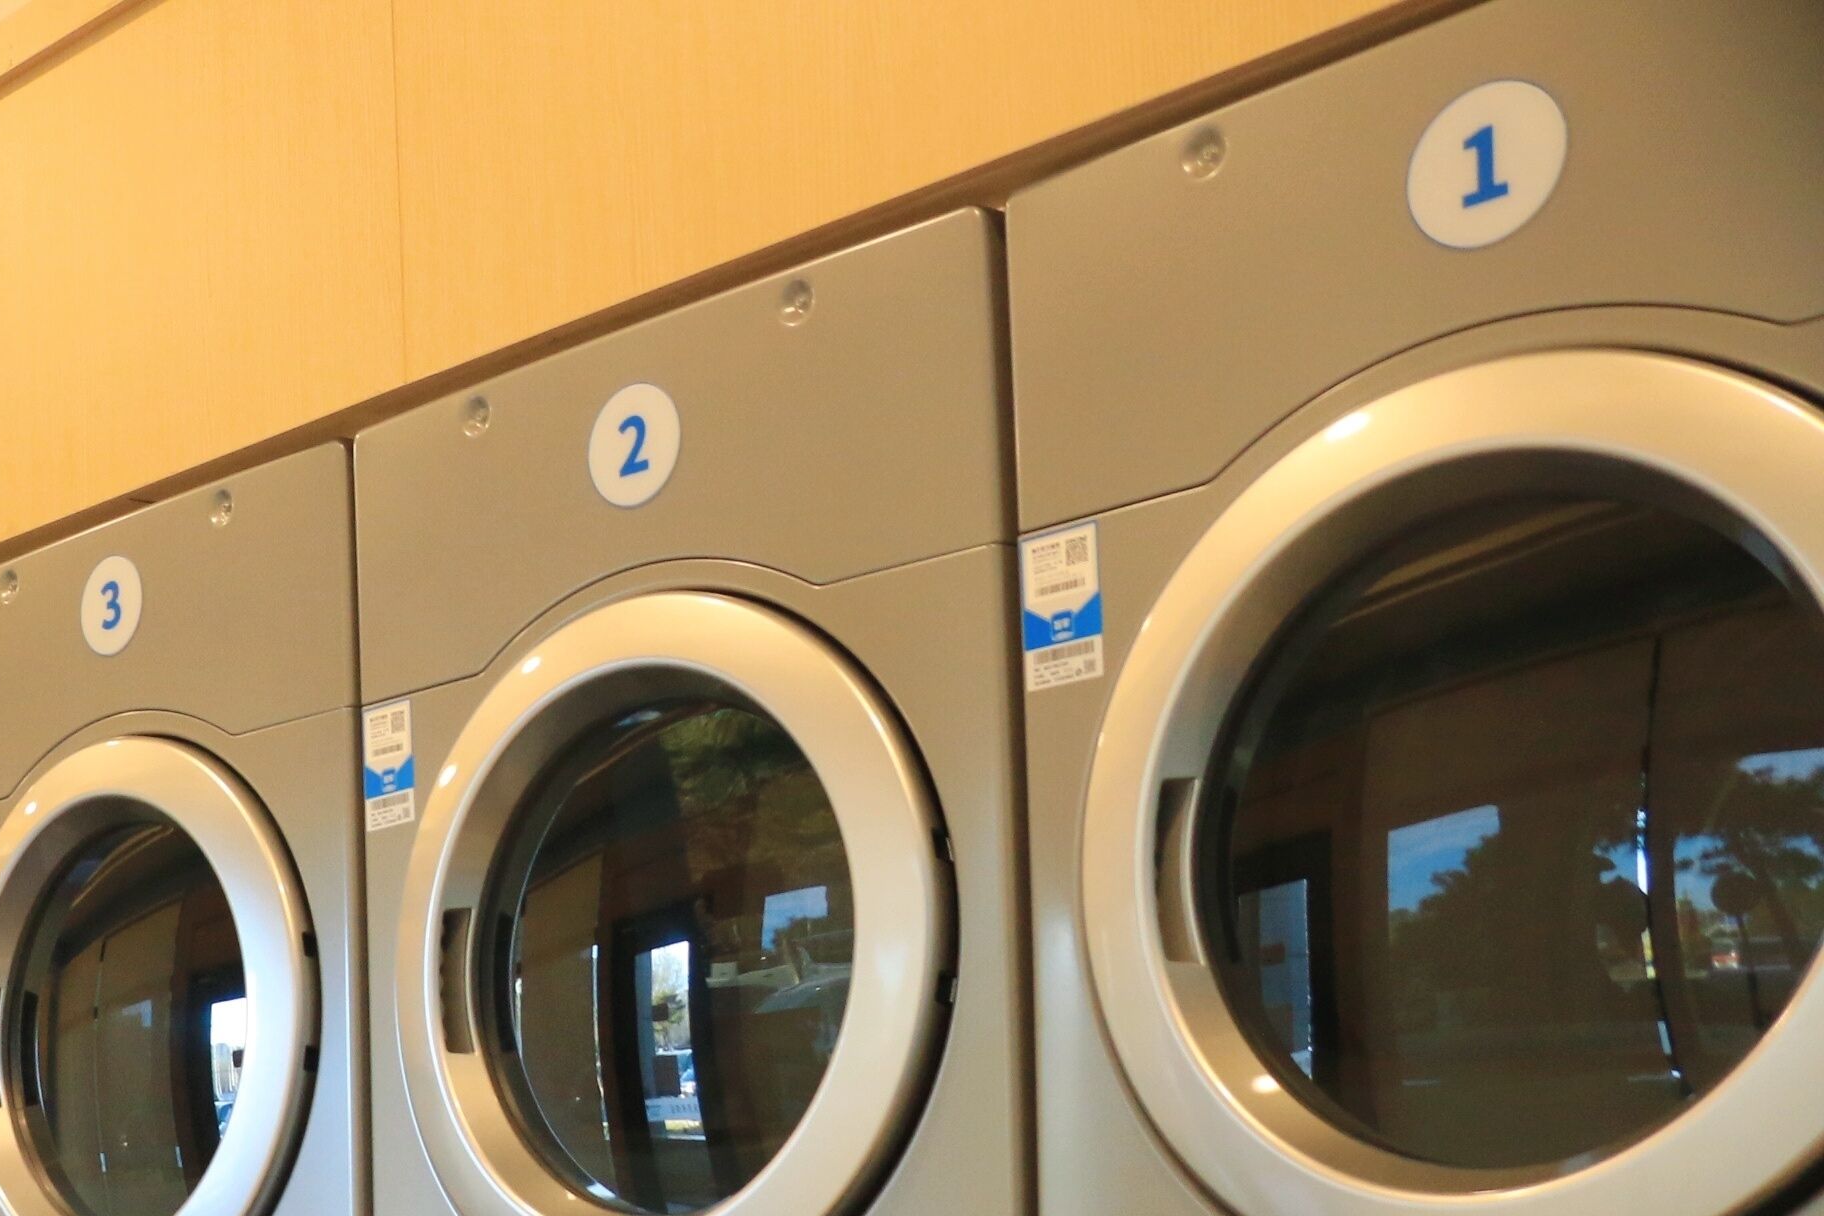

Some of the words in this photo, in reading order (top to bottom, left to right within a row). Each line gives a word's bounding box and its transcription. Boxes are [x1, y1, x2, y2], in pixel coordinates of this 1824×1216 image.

[1463, 126, 1510, 208] 1
[618, 415, 650, 477] 2
[101, 580, 122, 631] 3
